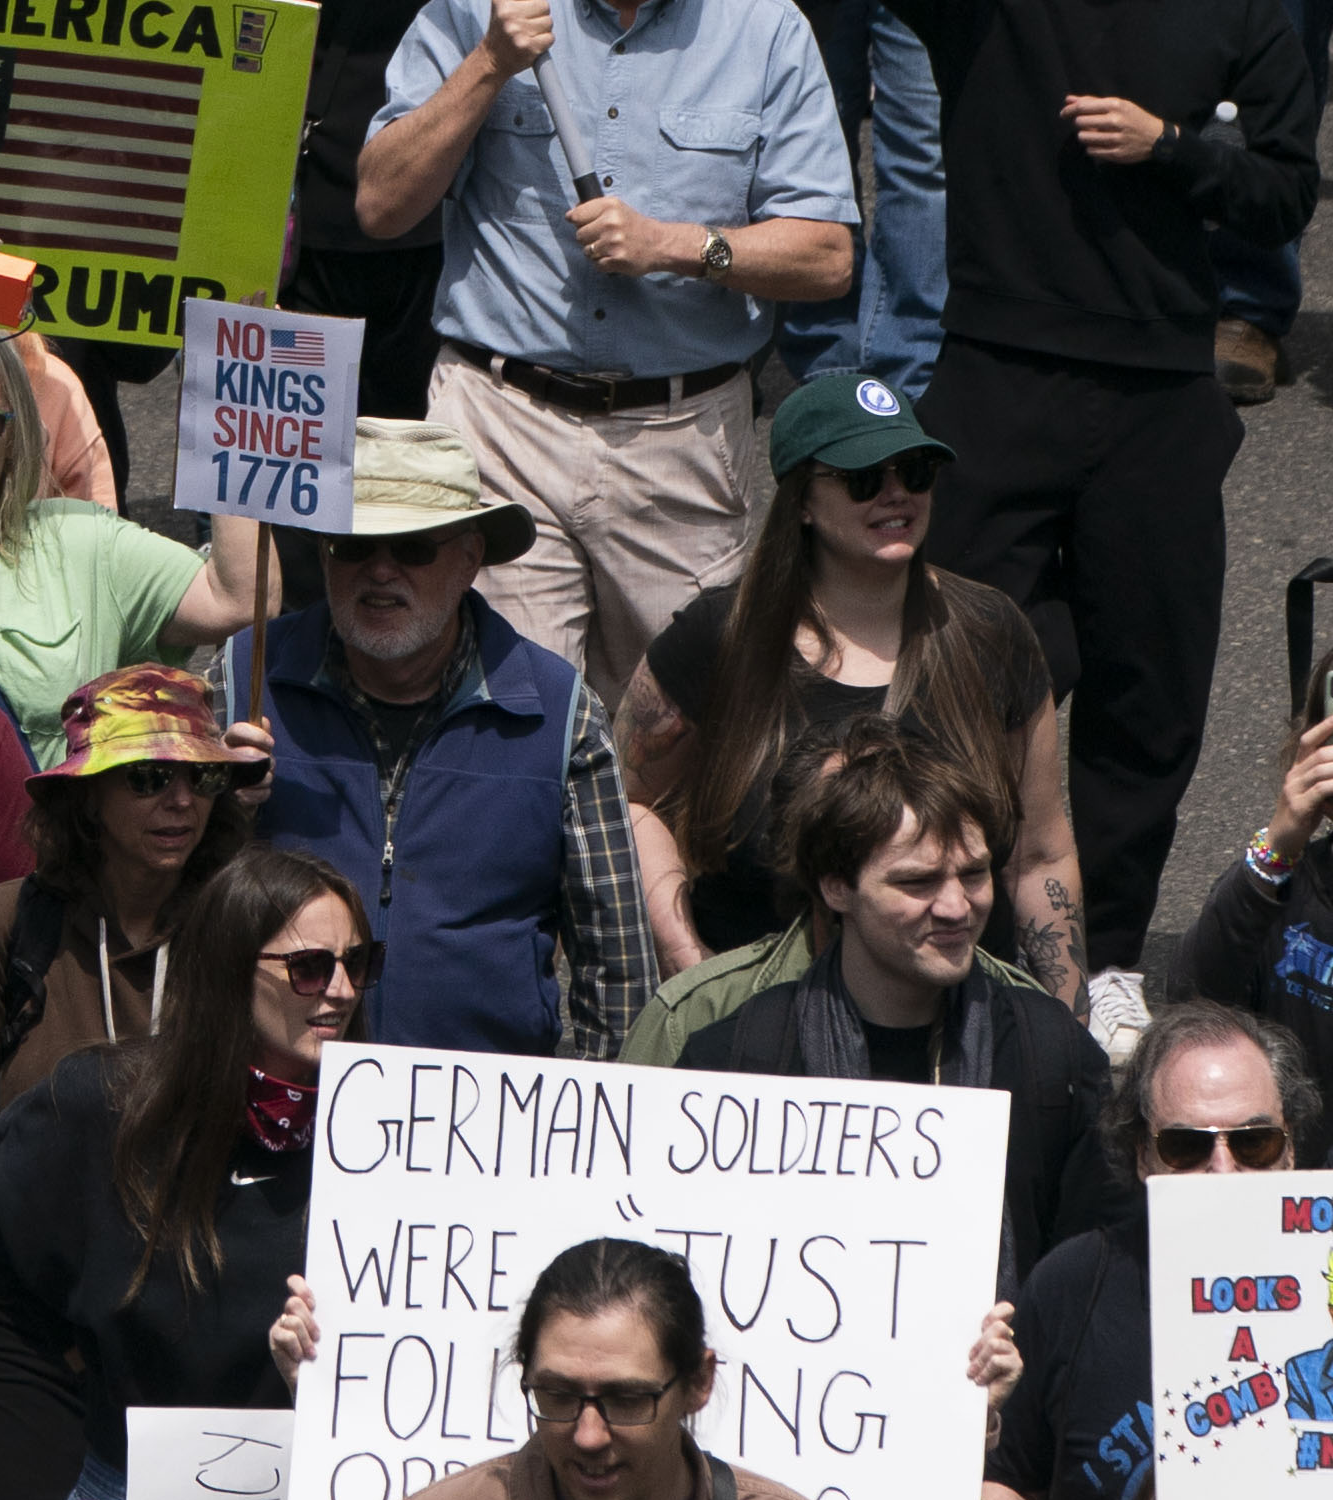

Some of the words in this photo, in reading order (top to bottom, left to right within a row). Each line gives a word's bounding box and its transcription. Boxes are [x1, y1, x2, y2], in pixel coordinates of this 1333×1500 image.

[215, 317, 266, 364] NO
[214, 360, 325, 416] KINGS
[213, 405, 324, 460] SINCE
[325, 1057, 635, 1180] GERMAN
[667, 1088, 947, 1182] SOLDIERS
[1191, 1275, 1300, 1314] LOOKS
[1228, 1326, 1258, 1363] A
[1185, 1371, 1281, 1438] COMB
